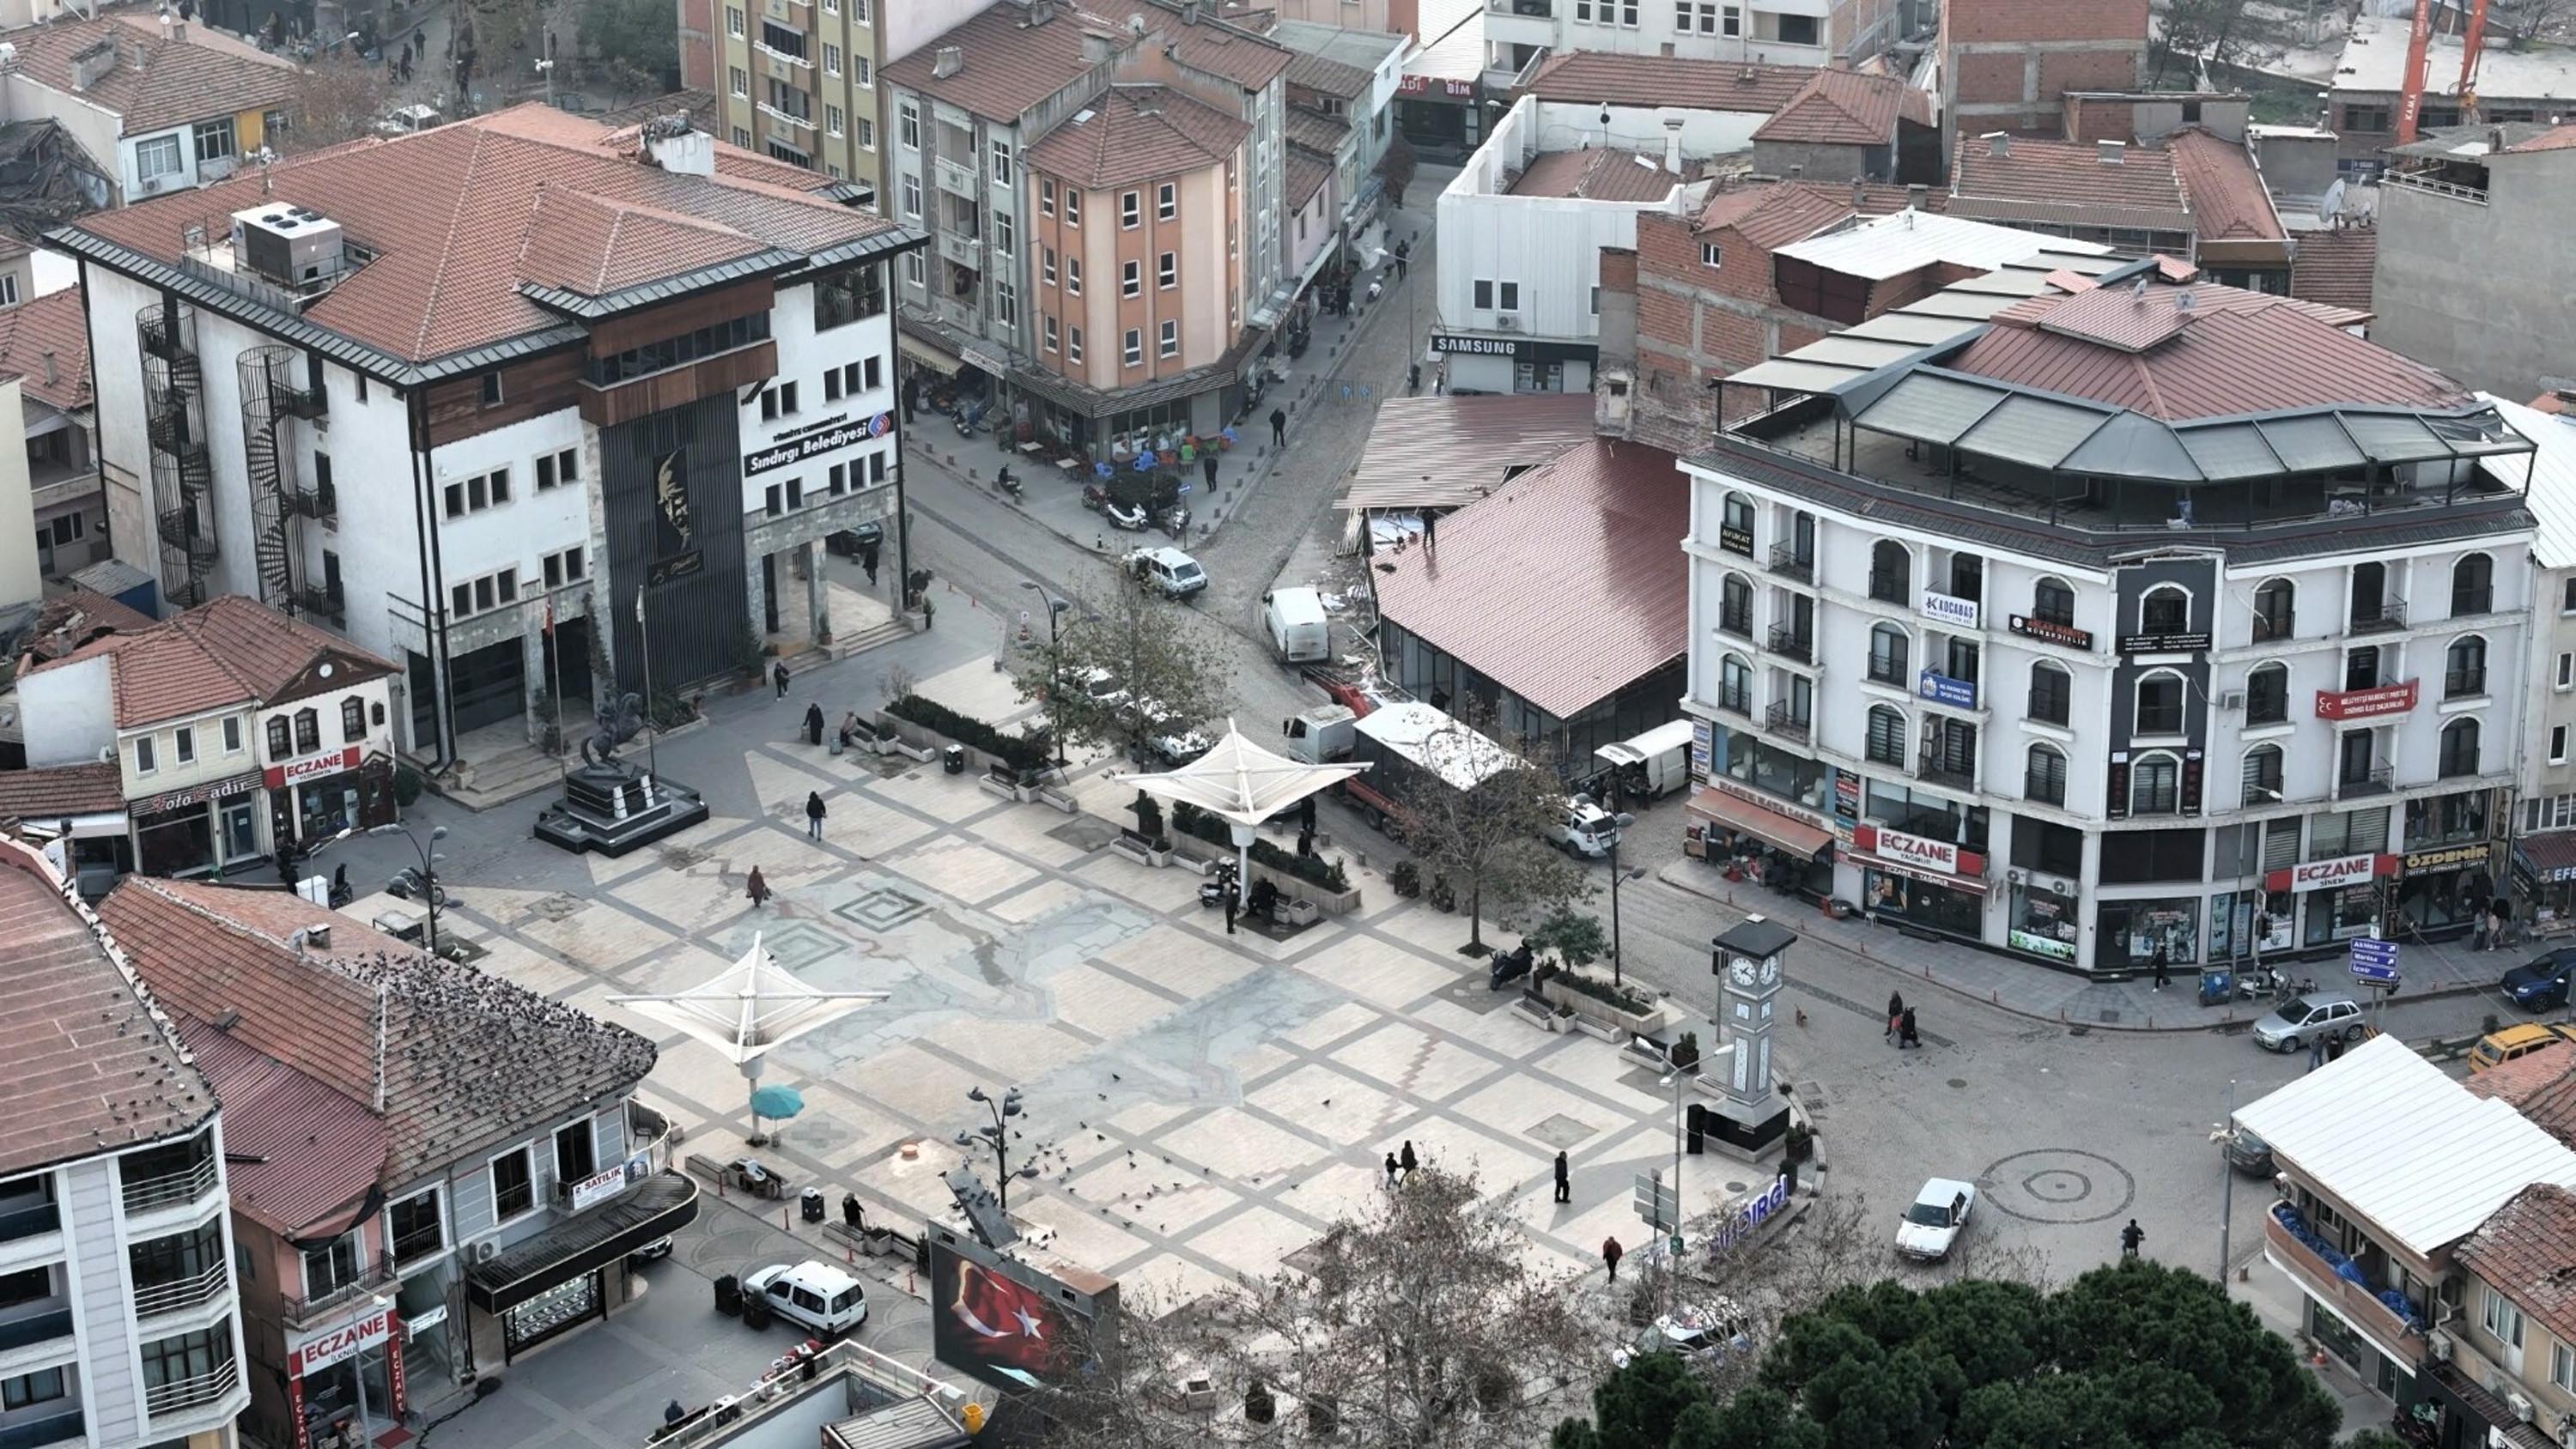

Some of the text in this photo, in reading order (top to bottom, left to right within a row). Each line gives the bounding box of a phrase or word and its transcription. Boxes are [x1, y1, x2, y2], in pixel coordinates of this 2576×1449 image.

[1447, 81, 1470, 95] BİM
[1438, 338, 1516, 355] SAMSUNG
[750, 422, 867, 471] Sındırgı Belediyesi
[1939, 599, 1974, 619] KOCABAŞ
[287, 754, 342, 777] ECZANE
[1880, 833, 1953, 864] ECZANE
[1900, 853, 1932, 865] YAĞMUR
[2406, 846, 2489, 869] ÖZDEMİR
[2298, 858, 2370, 882] ECZANE
[2319, 877, 2347, 888] SİNEM
[585, 1167, 622, 1190] SATILIK
[306, 1315, 386, 1363] ECZANE
[331, 1345, 359, 1362] İLKNU
[392, 1350, 404, 1412] ECZANE
[295, 1395, 308, 1449] ECZAN
